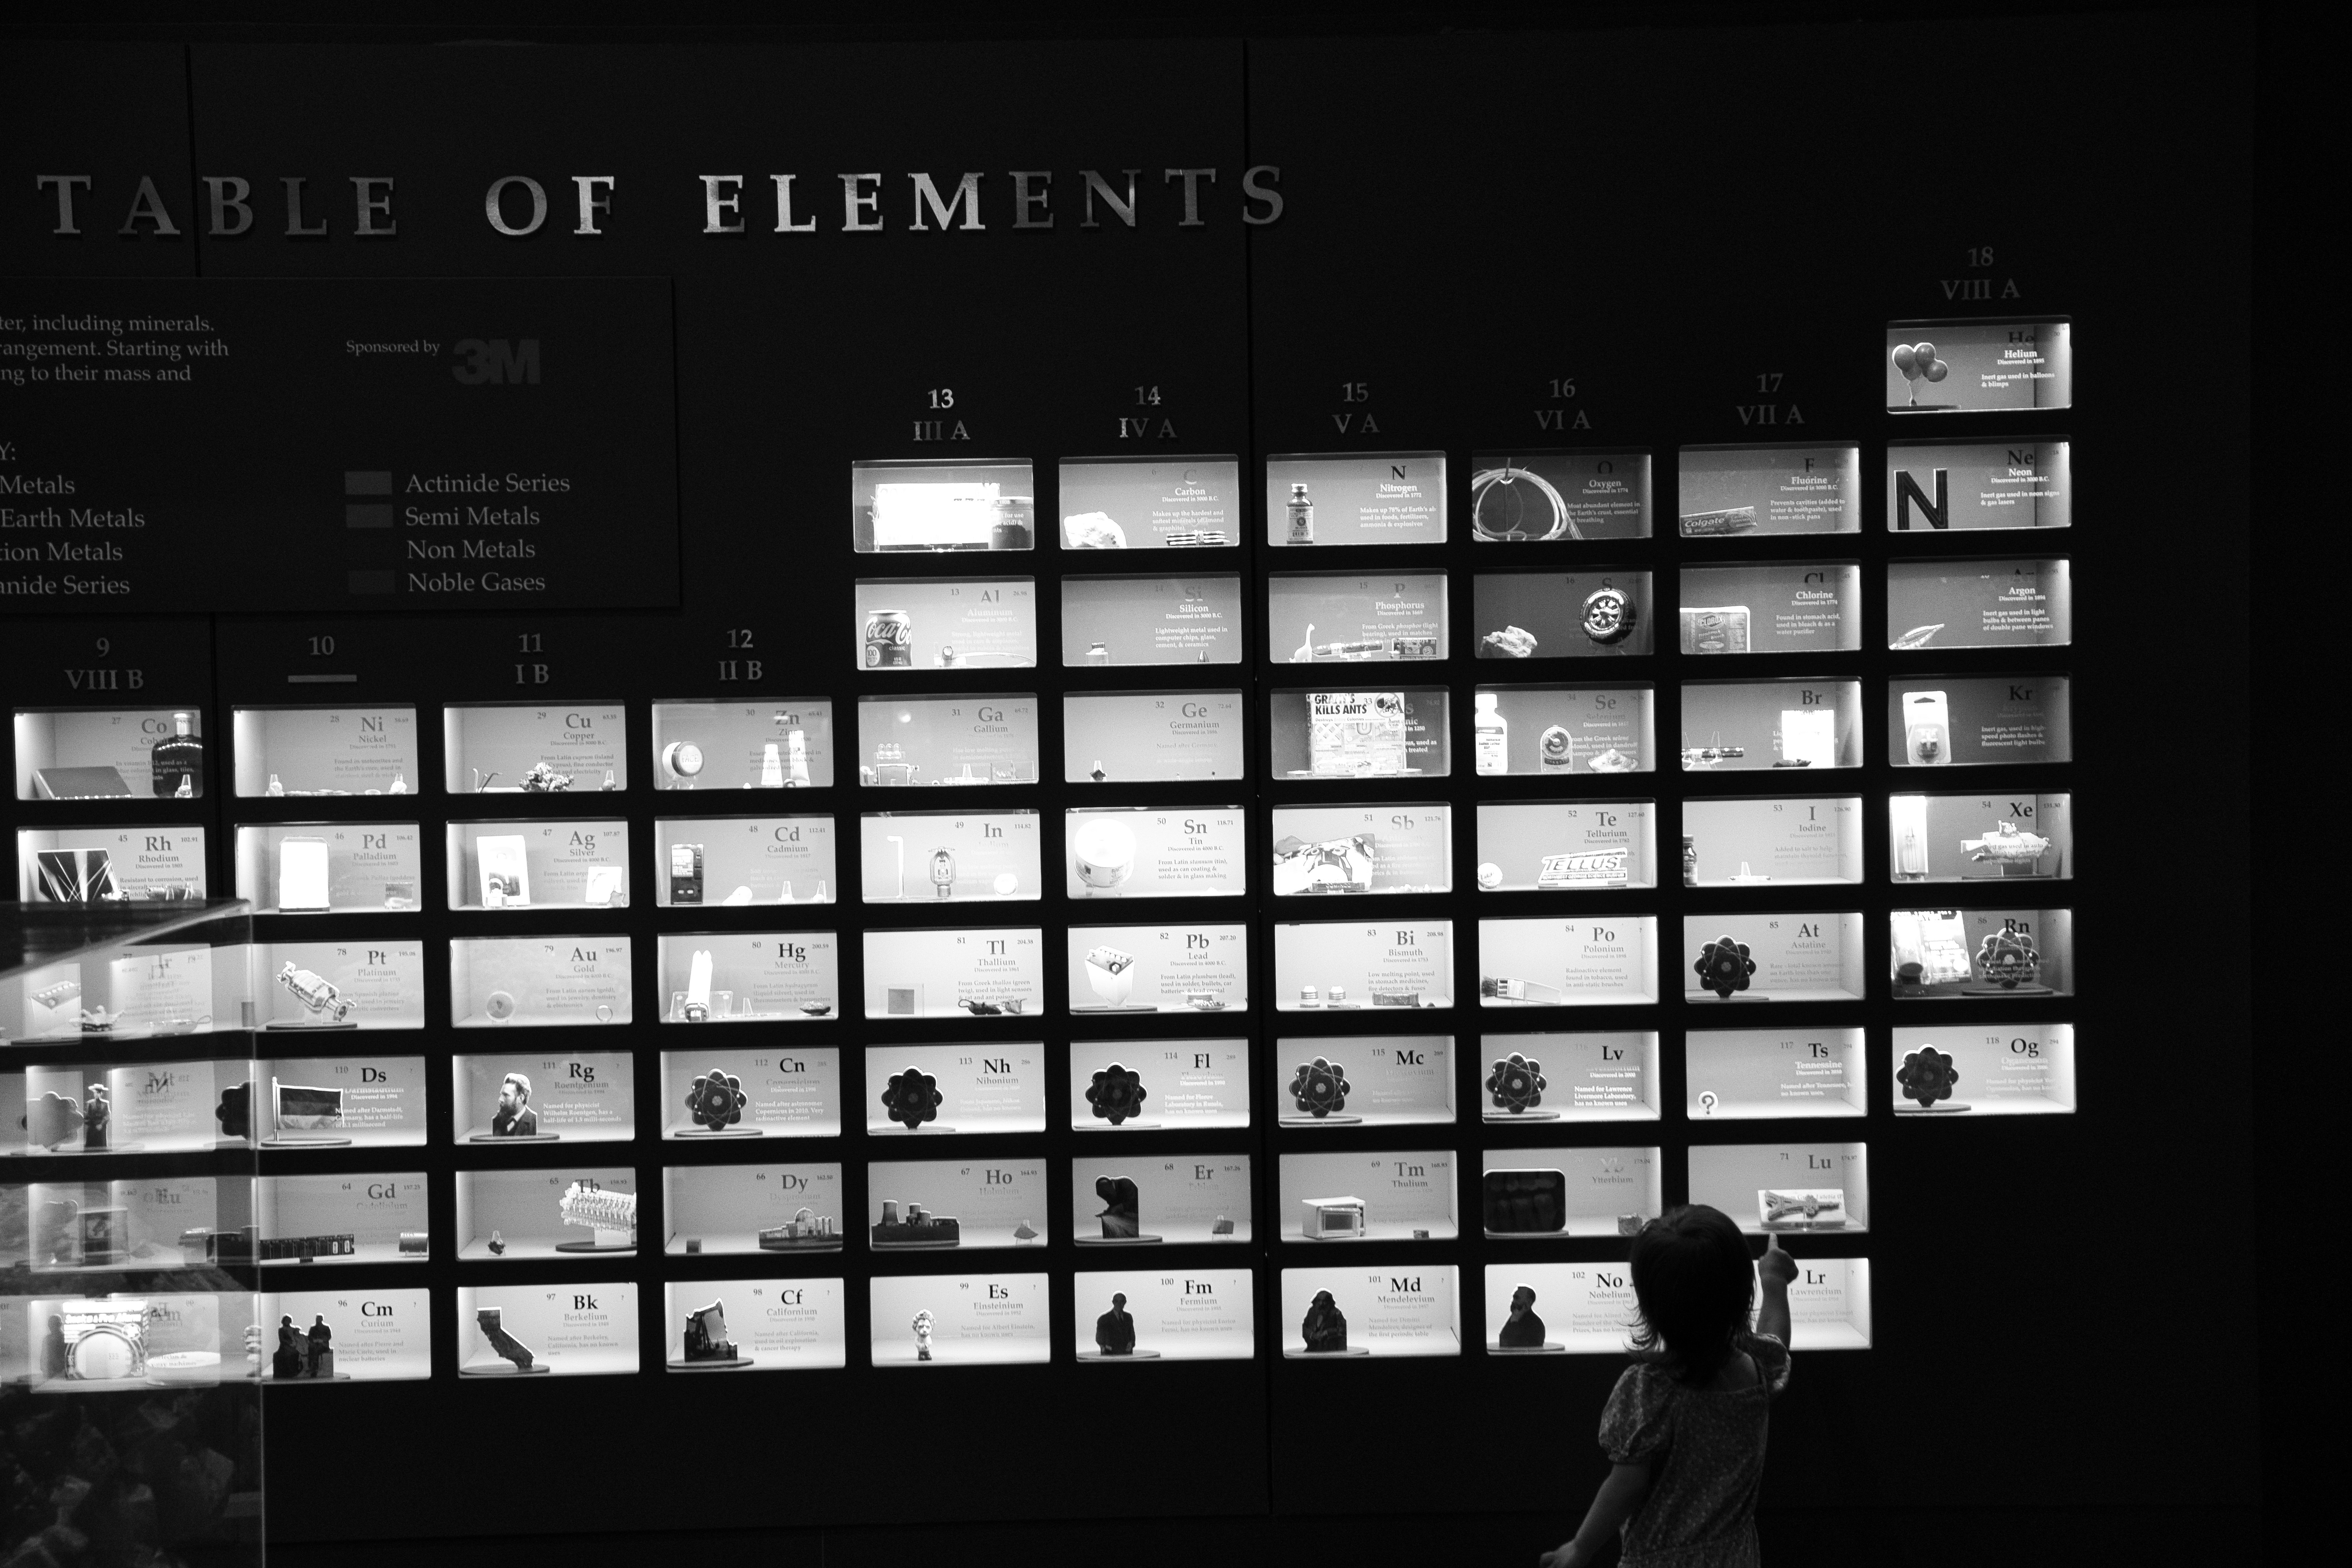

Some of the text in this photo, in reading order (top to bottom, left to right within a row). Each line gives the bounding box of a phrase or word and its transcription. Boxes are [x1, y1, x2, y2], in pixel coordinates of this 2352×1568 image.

[36, 165, 1284, 235] TABLE OF ELEMENTS
[1967, 246, 1994, 266] 18
[1941, 279, 2020, 300] VIII A
[33, 315, 123, 336] including
[129, 315, 214, 331] minerals.
[0, 339, 229, 361] angement. Starting with
[346, 340, 440, 356] Sponsored by
[2004, 350, 2038, 358] Helium
[452, 339, 540, 385] 3M
[31, 366, 49, 381] to
[55, 364, 98, 381] their
[104, 368, 151, 381] mass
[157, 365, 191, 381] and
[1549, 378, 1575, 398] 16
[1757, 373, 1783, 392] 17
[928, 389, 954, 409] 13
[1134, 386, 1161, 405] 14
[1342, 383, 1369, 402] 15
[1534, 409, 1591, 430] VI A
[1737, 404, 1805, 425] VII A
[913, 420, 970, 441] III A
[1119, 418, 1177, 438] IV A
[1333, 414, 1380, 434] V A
[2007, 450, 2033, 465] Ne
[1391, 466, 1406, 480] N
[1791, 476, 1827, 485] Fluorine
[0, 474, 75, 494] Metals
[406, 473, 570, 493] Actinide Series
[1380, 484, 1417, 493] Nitrogen
[1589, 479, 1621, 489] Oxygen
[1175, 487, 1205, 496] Carbon
[1, 507, 145, 528] Earth Metals
[406, 506, 540, 526] Semi Metals
[1685, 518, 1725, 527] Colgate
[47, 541, 123, 561] Metals
[407, 539, 535, 559] Non Metals
[64, 575, 130, 594] Series
[408, 572, 545, 592] Noble Gases
[1796, 591, 1833, 600] Chlorine
[2009, 587, 2036, 596] Argon
[1375, 601, 1425, 611] Phosphorus
[1700, 615, 1723, 626] CLOROX
[97, 638, 109, 656] 9
[308, 636, 334, 655] 10
[518, 634, 543, 653] 11
[727, 629, 753, 649] 12
[515, 664, 549, 684] I B
[718, 660, 762, 681] II B
[64, 670, 144, 690] VIII B
[1802, 690, 1822, 706] Br
[1182, 703, 1207, 718] Ge
[1316, 704, 1367, 714] KILLS ANTS
[142, 718, 168, 735] Co
[361, 716, 384, 732] Ni
[566, 714, 591, 729] Cu
[1170, 721, 1219, 729] Germanium
[359, 735, 387, 743] Nickel
[563, 731, 594, 741] Copper
[2009, 802, 2033, 818] Xe
[1184, 819, 1207, 834] Sn
[1595, 811, 1617, 827] Te
[775, 826, 800, 842] Cd
[983, 823, 1003, 838] In
[1586, 830, 1627, 838] Tellurium
[145, 836, 171, 852] Rh
[363, 833, 387, 850] Pd
[569, 830, 595, 850] Ag
[353, 851, 396, 861] Palladium
[570, 848, 594, 857] Silver
[767, 844, 808, 853] Cadmium
[139, 854, 179, 862] Rhodium
[1545, 857, 1618, 870] TELLUS
[1396, 930, 1415, 945] Bi
[1592, 927, 1615, 942] Po
[1798, 923, 1819, 937] At
[986, 940, 1006, 954] Tl
[1186, 934, 1209, 948] Pb
[367, 950, 387, 965] Pt
[571, 947, 597, 961] Au
[778, 943, 806, 962] Hg
[1602, 1046, 1623, 1060] Lv
[1809, 1043, 1828, 1057] Ts
[2011, 1038, 2039, 1057] Og
[779, 1058, 805, 1073] Cn
[1194, 1053, 1210, 1068] Fl
[1396, 1050, 1424, 1065] Mc
[569, 1063, 594, 1082] Rg
[983, 1058, 1010, 1074] Nh
[361, 1067, 386, 1083] Ds
[1390, 1277, 1421, 1293] Md
[1596, 1273, 1623, 1288] No
[1805, 1269, 1825, 1285] Lr
[988, 1284, 1008, 1299] Es
[1184, 1280, 1212, 1295] Fm
[574, 1294, 598, 1311] Bk
[781, 1289, 802, 1305] Cf
[361, 1302, 393, 1317] Cm
